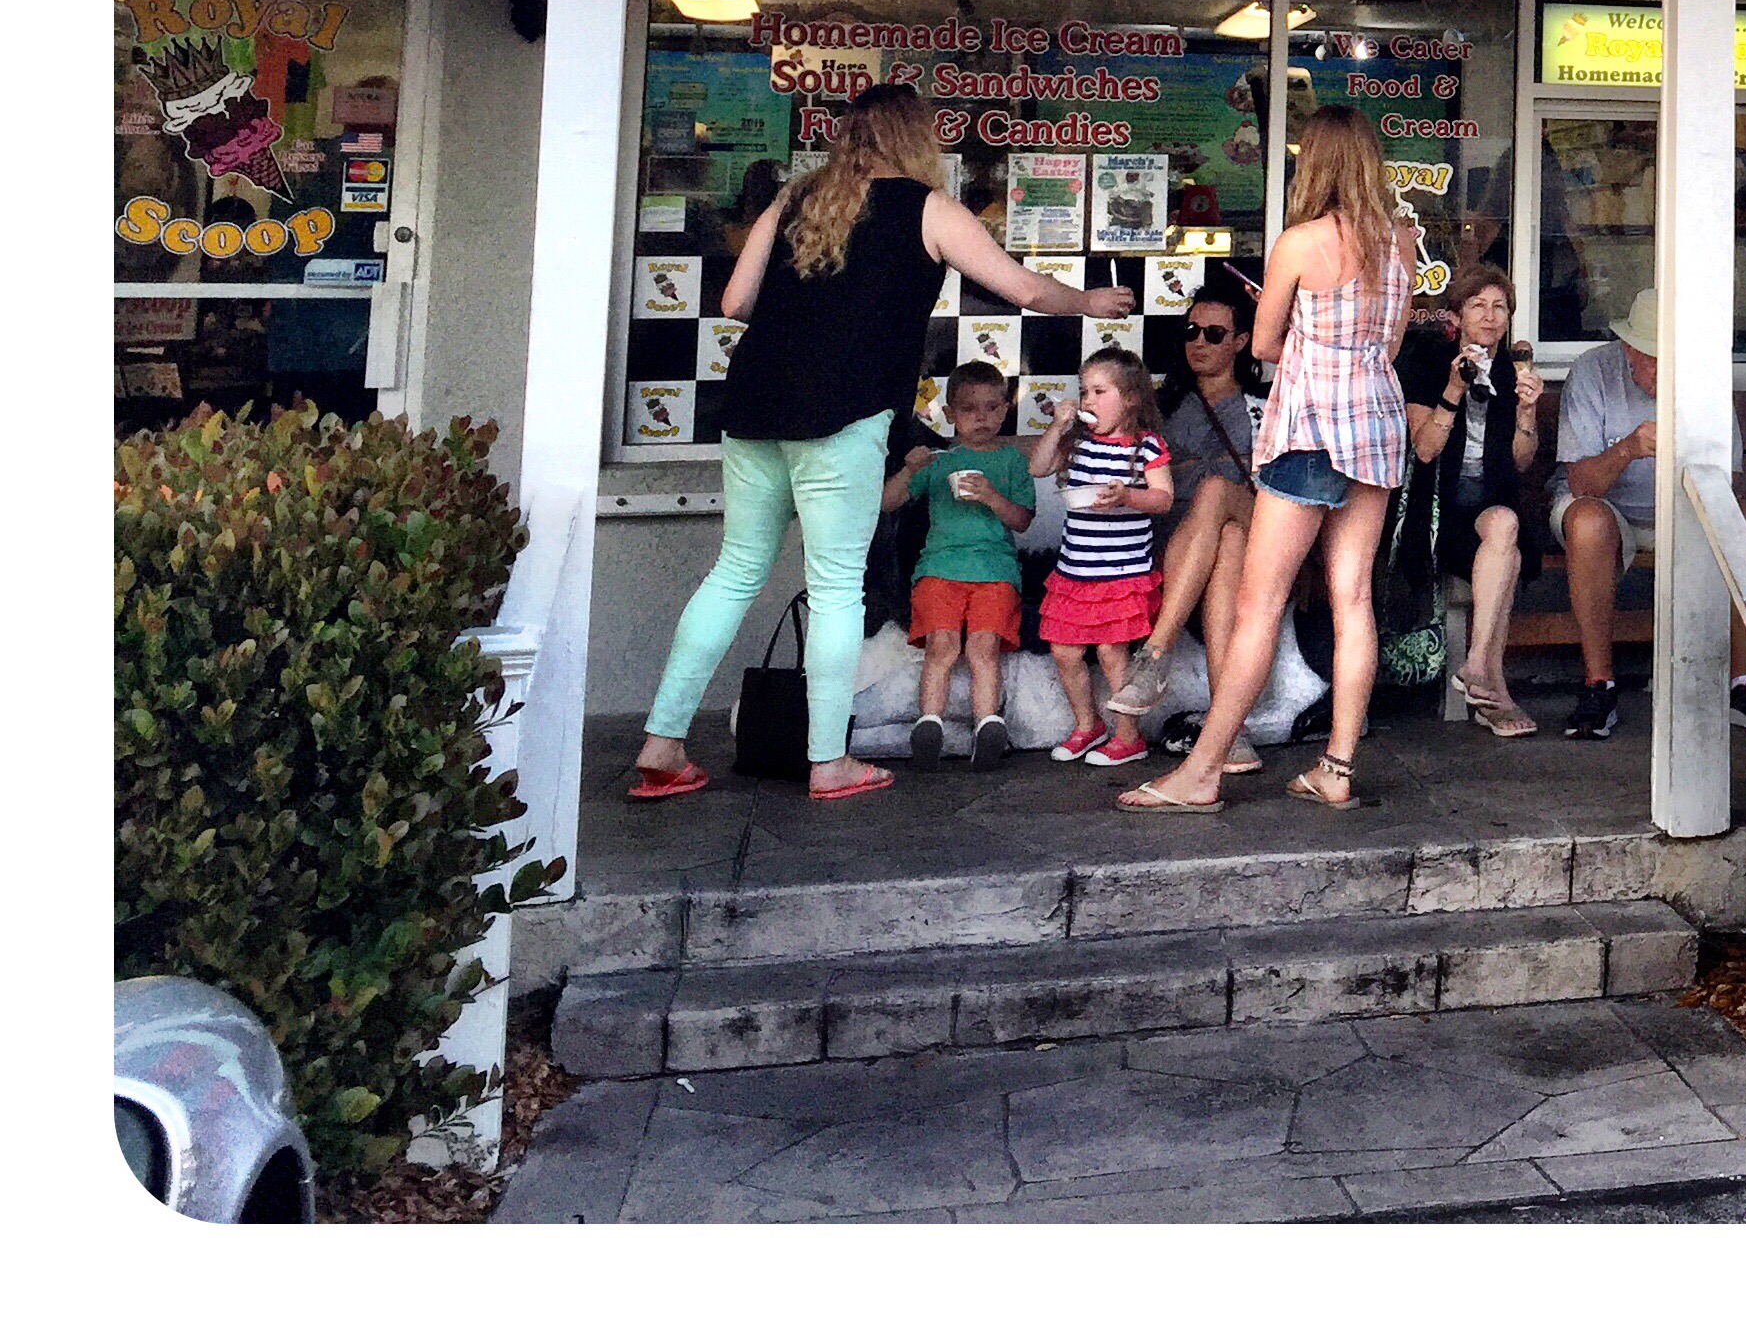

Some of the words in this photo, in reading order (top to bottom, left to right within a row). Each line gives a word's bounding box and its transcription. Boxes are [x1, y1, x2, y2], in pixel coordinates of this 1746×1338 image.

[750, 12, 981, 51] Homemade
[990, 18, 1050, 53] Ice
[1059, 20, 1183, 57] Cream
[1333, 34, 1379, 58] We
[1390, 34, 1473, 60] Cater
[1585, 32, 1663, 62] Roya
[770, 59, 873, 103] Soup
[932, 62, 1160, 102] Sandwiches
[1346, 73, 1422, 98] Food
[1432, 74, 1459, 99] &
[932, 109, 970, 144] &
[978, 110, 1131, 148] Candies
[1380, 113, 1479, 138] Cream
[1032, 167, 1083, 177] Easter!
[1033, 156, 1081, 168] Happy
[1107, 155, 1155, 166] March's
[1384, 164, 1450, 192] oyal
[350, 191, 379, 203] VISA
[115, 196, 335, 258] Scoop
[355, 264, 380, 279] ADT
